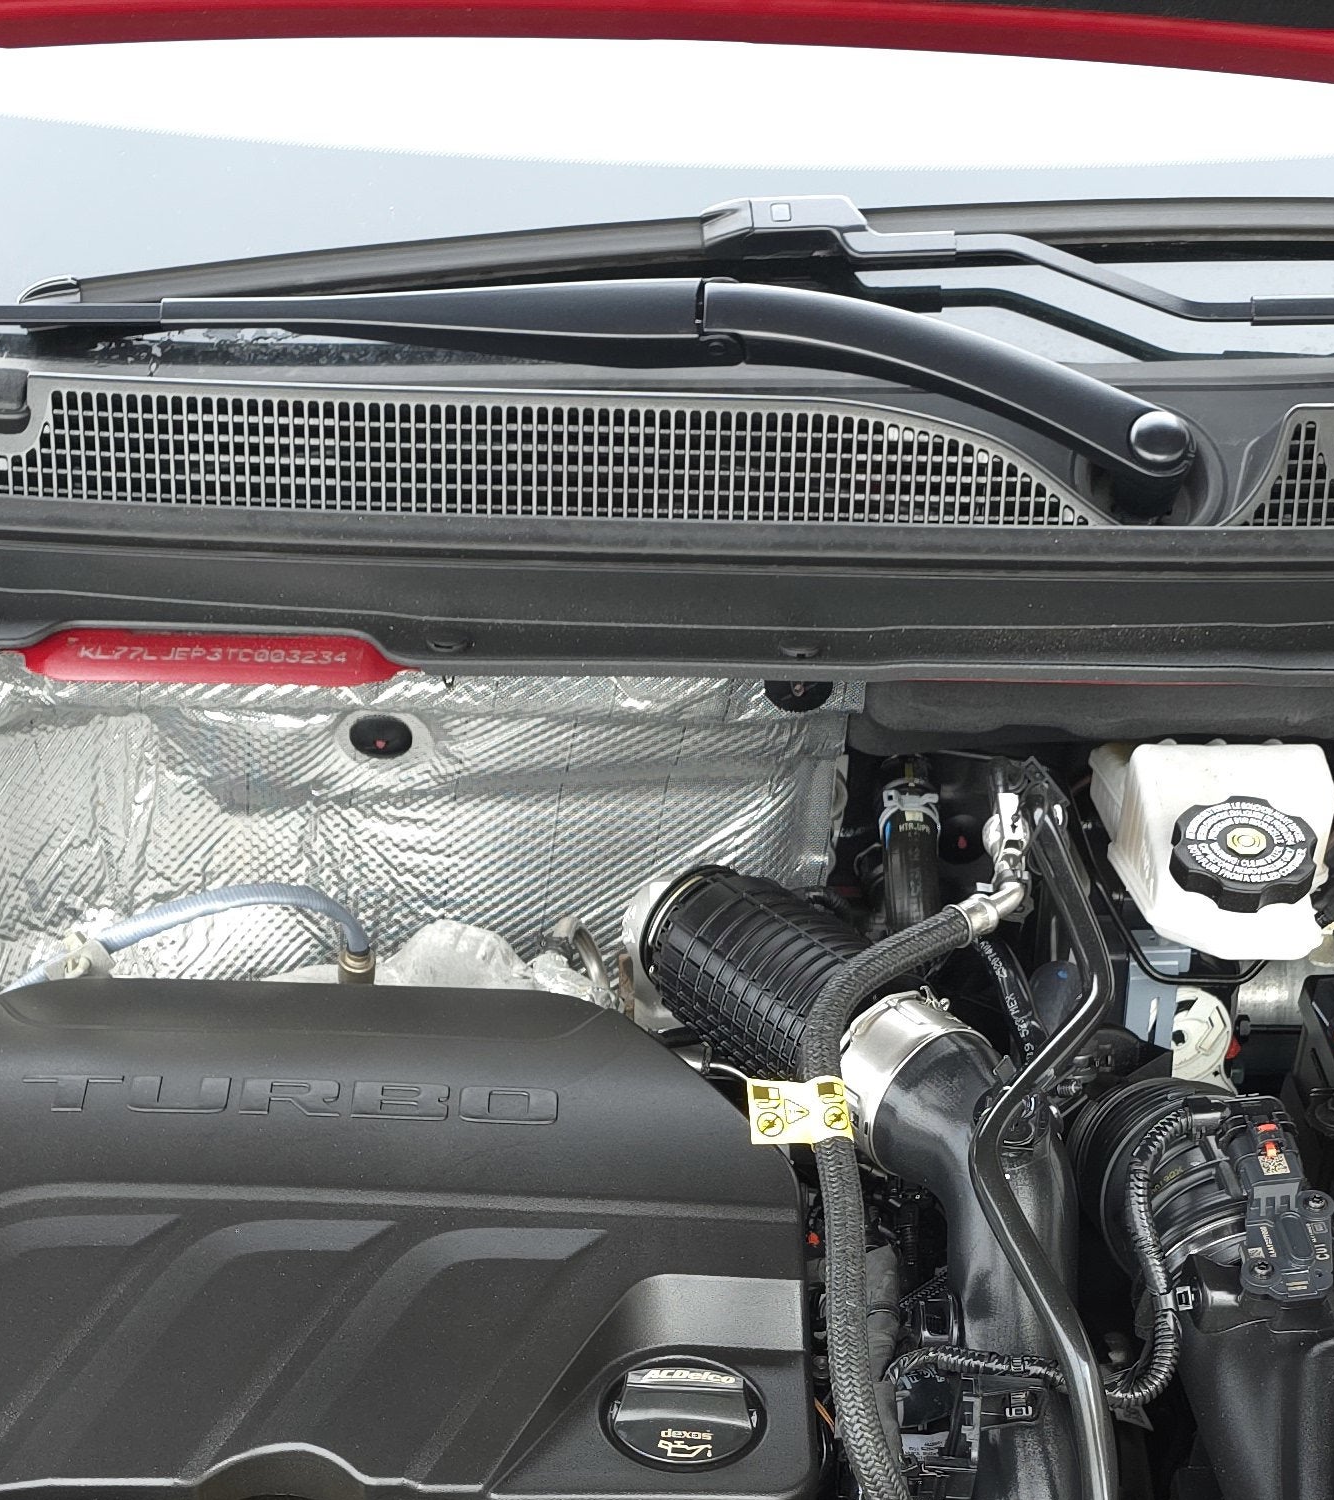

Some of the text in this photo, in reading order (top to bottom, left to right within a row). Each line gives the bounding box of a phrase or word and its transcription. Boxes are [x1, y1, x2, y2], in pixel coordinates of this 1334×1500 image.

[23, 1074, 560, 1125] TURBO
[641, 1368, 736, 1385] ACDelco
[659, 1428, 714, 1441] dexos
